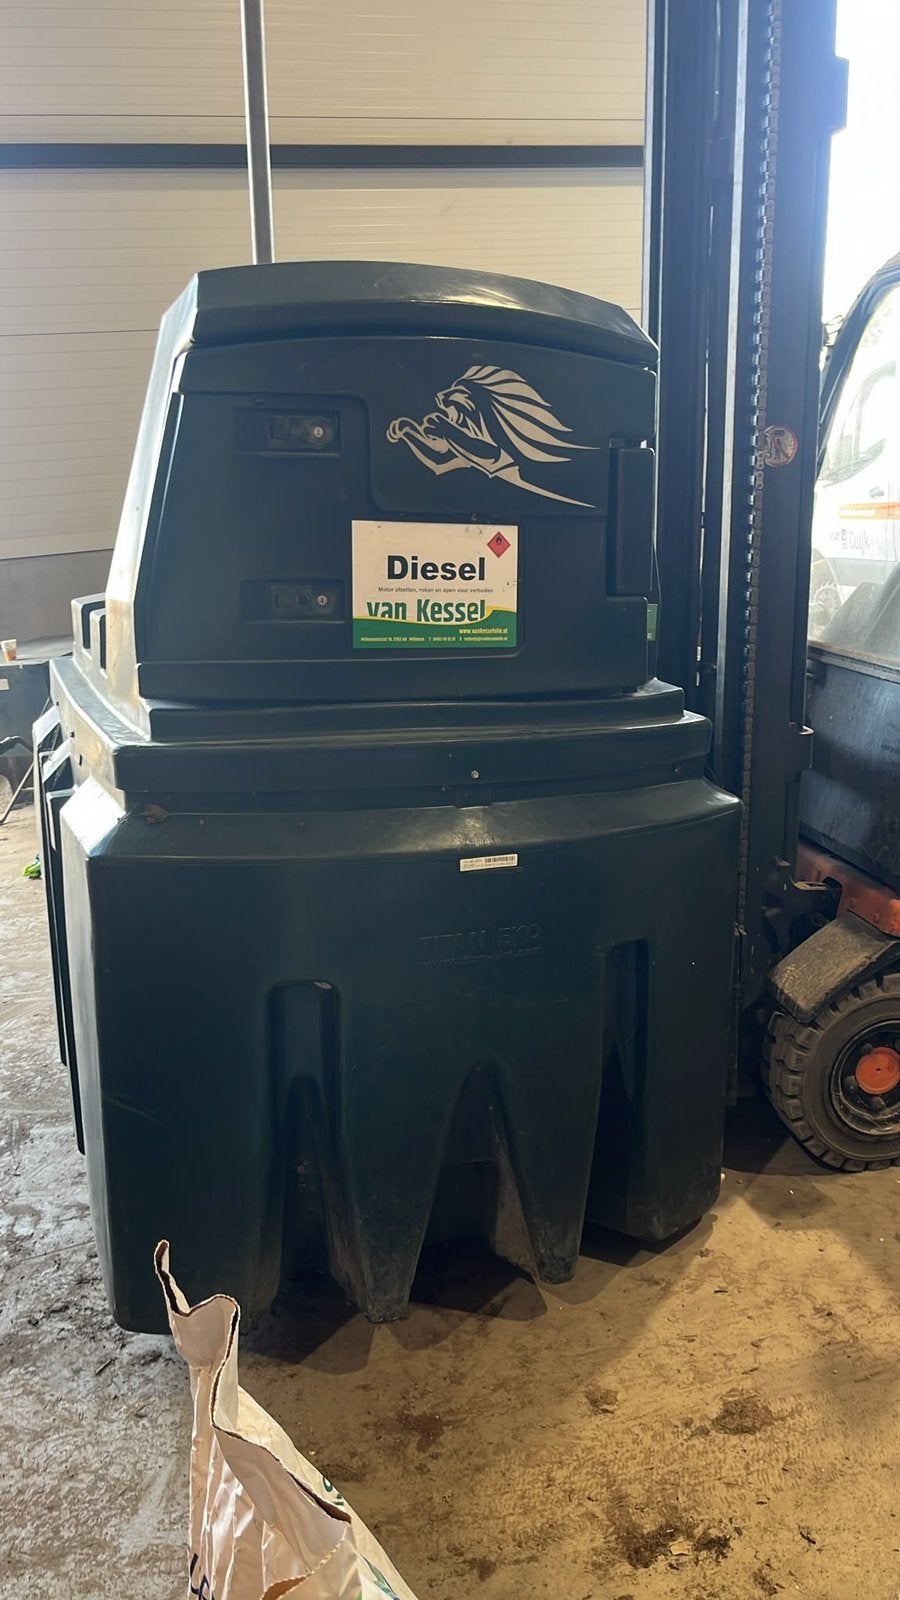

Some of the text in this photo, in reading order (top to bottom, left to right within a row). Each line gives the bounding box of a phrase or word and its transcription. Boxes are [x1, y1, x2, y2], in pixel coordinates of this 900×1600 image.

[387, 555, 485, 581] Diesel
[367, 599, 486, 623] van Kessel
